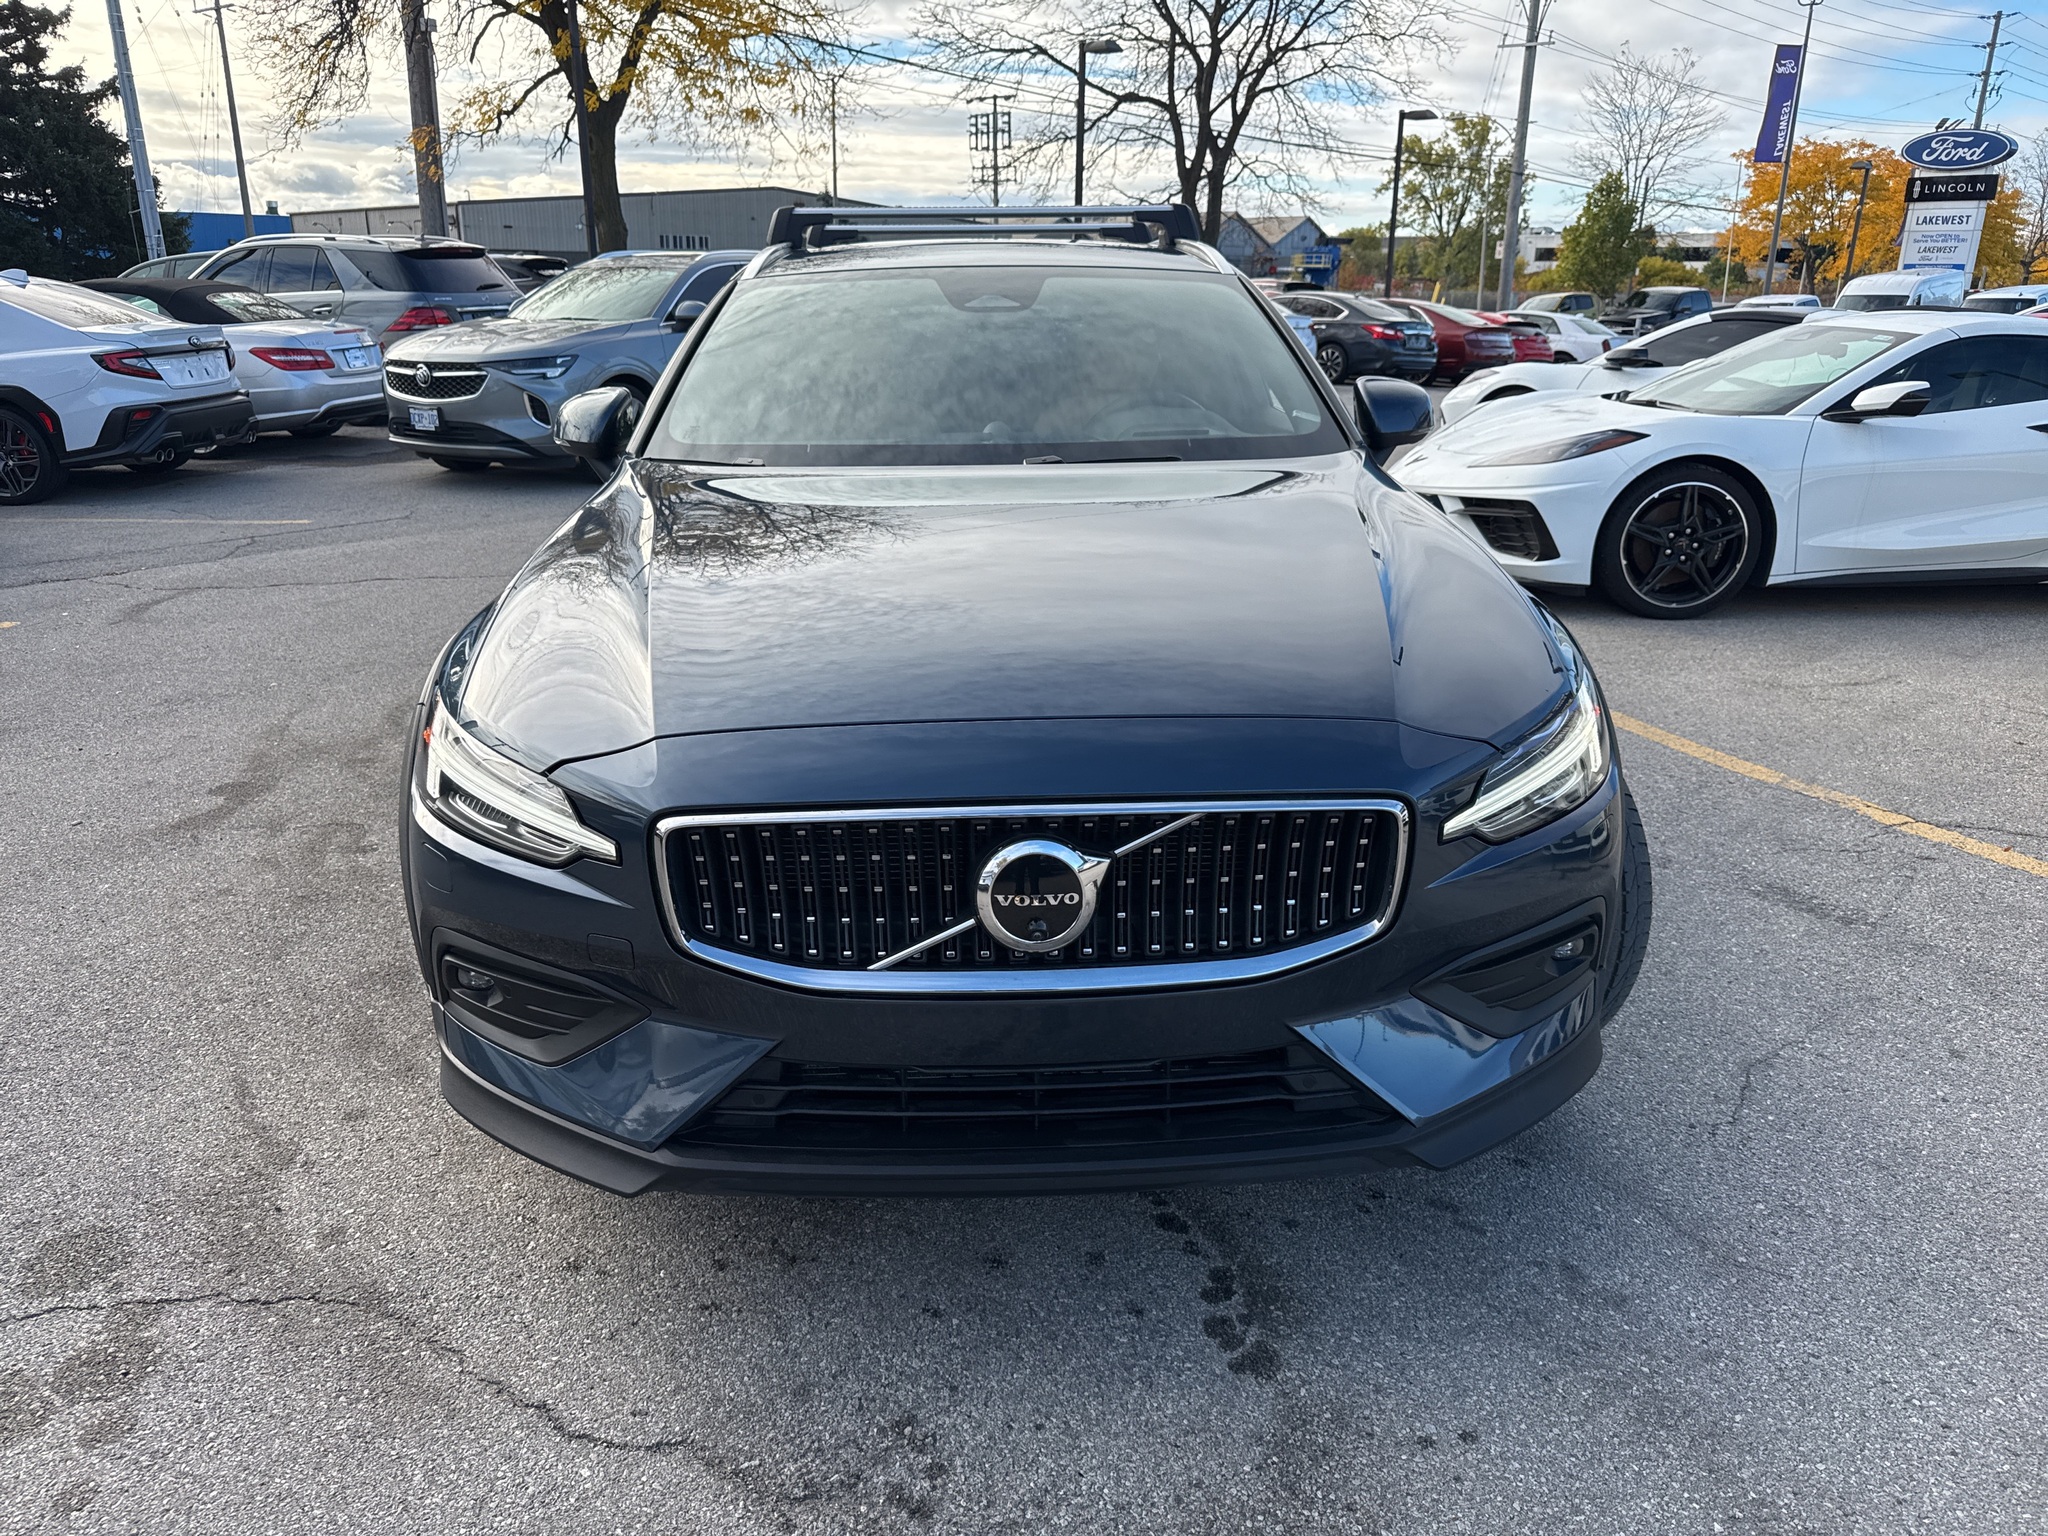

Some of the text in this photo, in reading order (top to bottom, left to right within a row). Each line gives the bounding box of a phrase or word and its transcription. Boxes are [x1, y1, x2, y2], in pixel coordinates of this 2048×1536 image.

[1922, 136, 1990, 162] Ford
[1924, 183, 1985, 193] LINCOLN
[1916, 215, 1971, 225] LAKEWEST
[1917, 246, 1958, 254] LAKEWEST
[994, 892, 1080, 907] VOLVO
